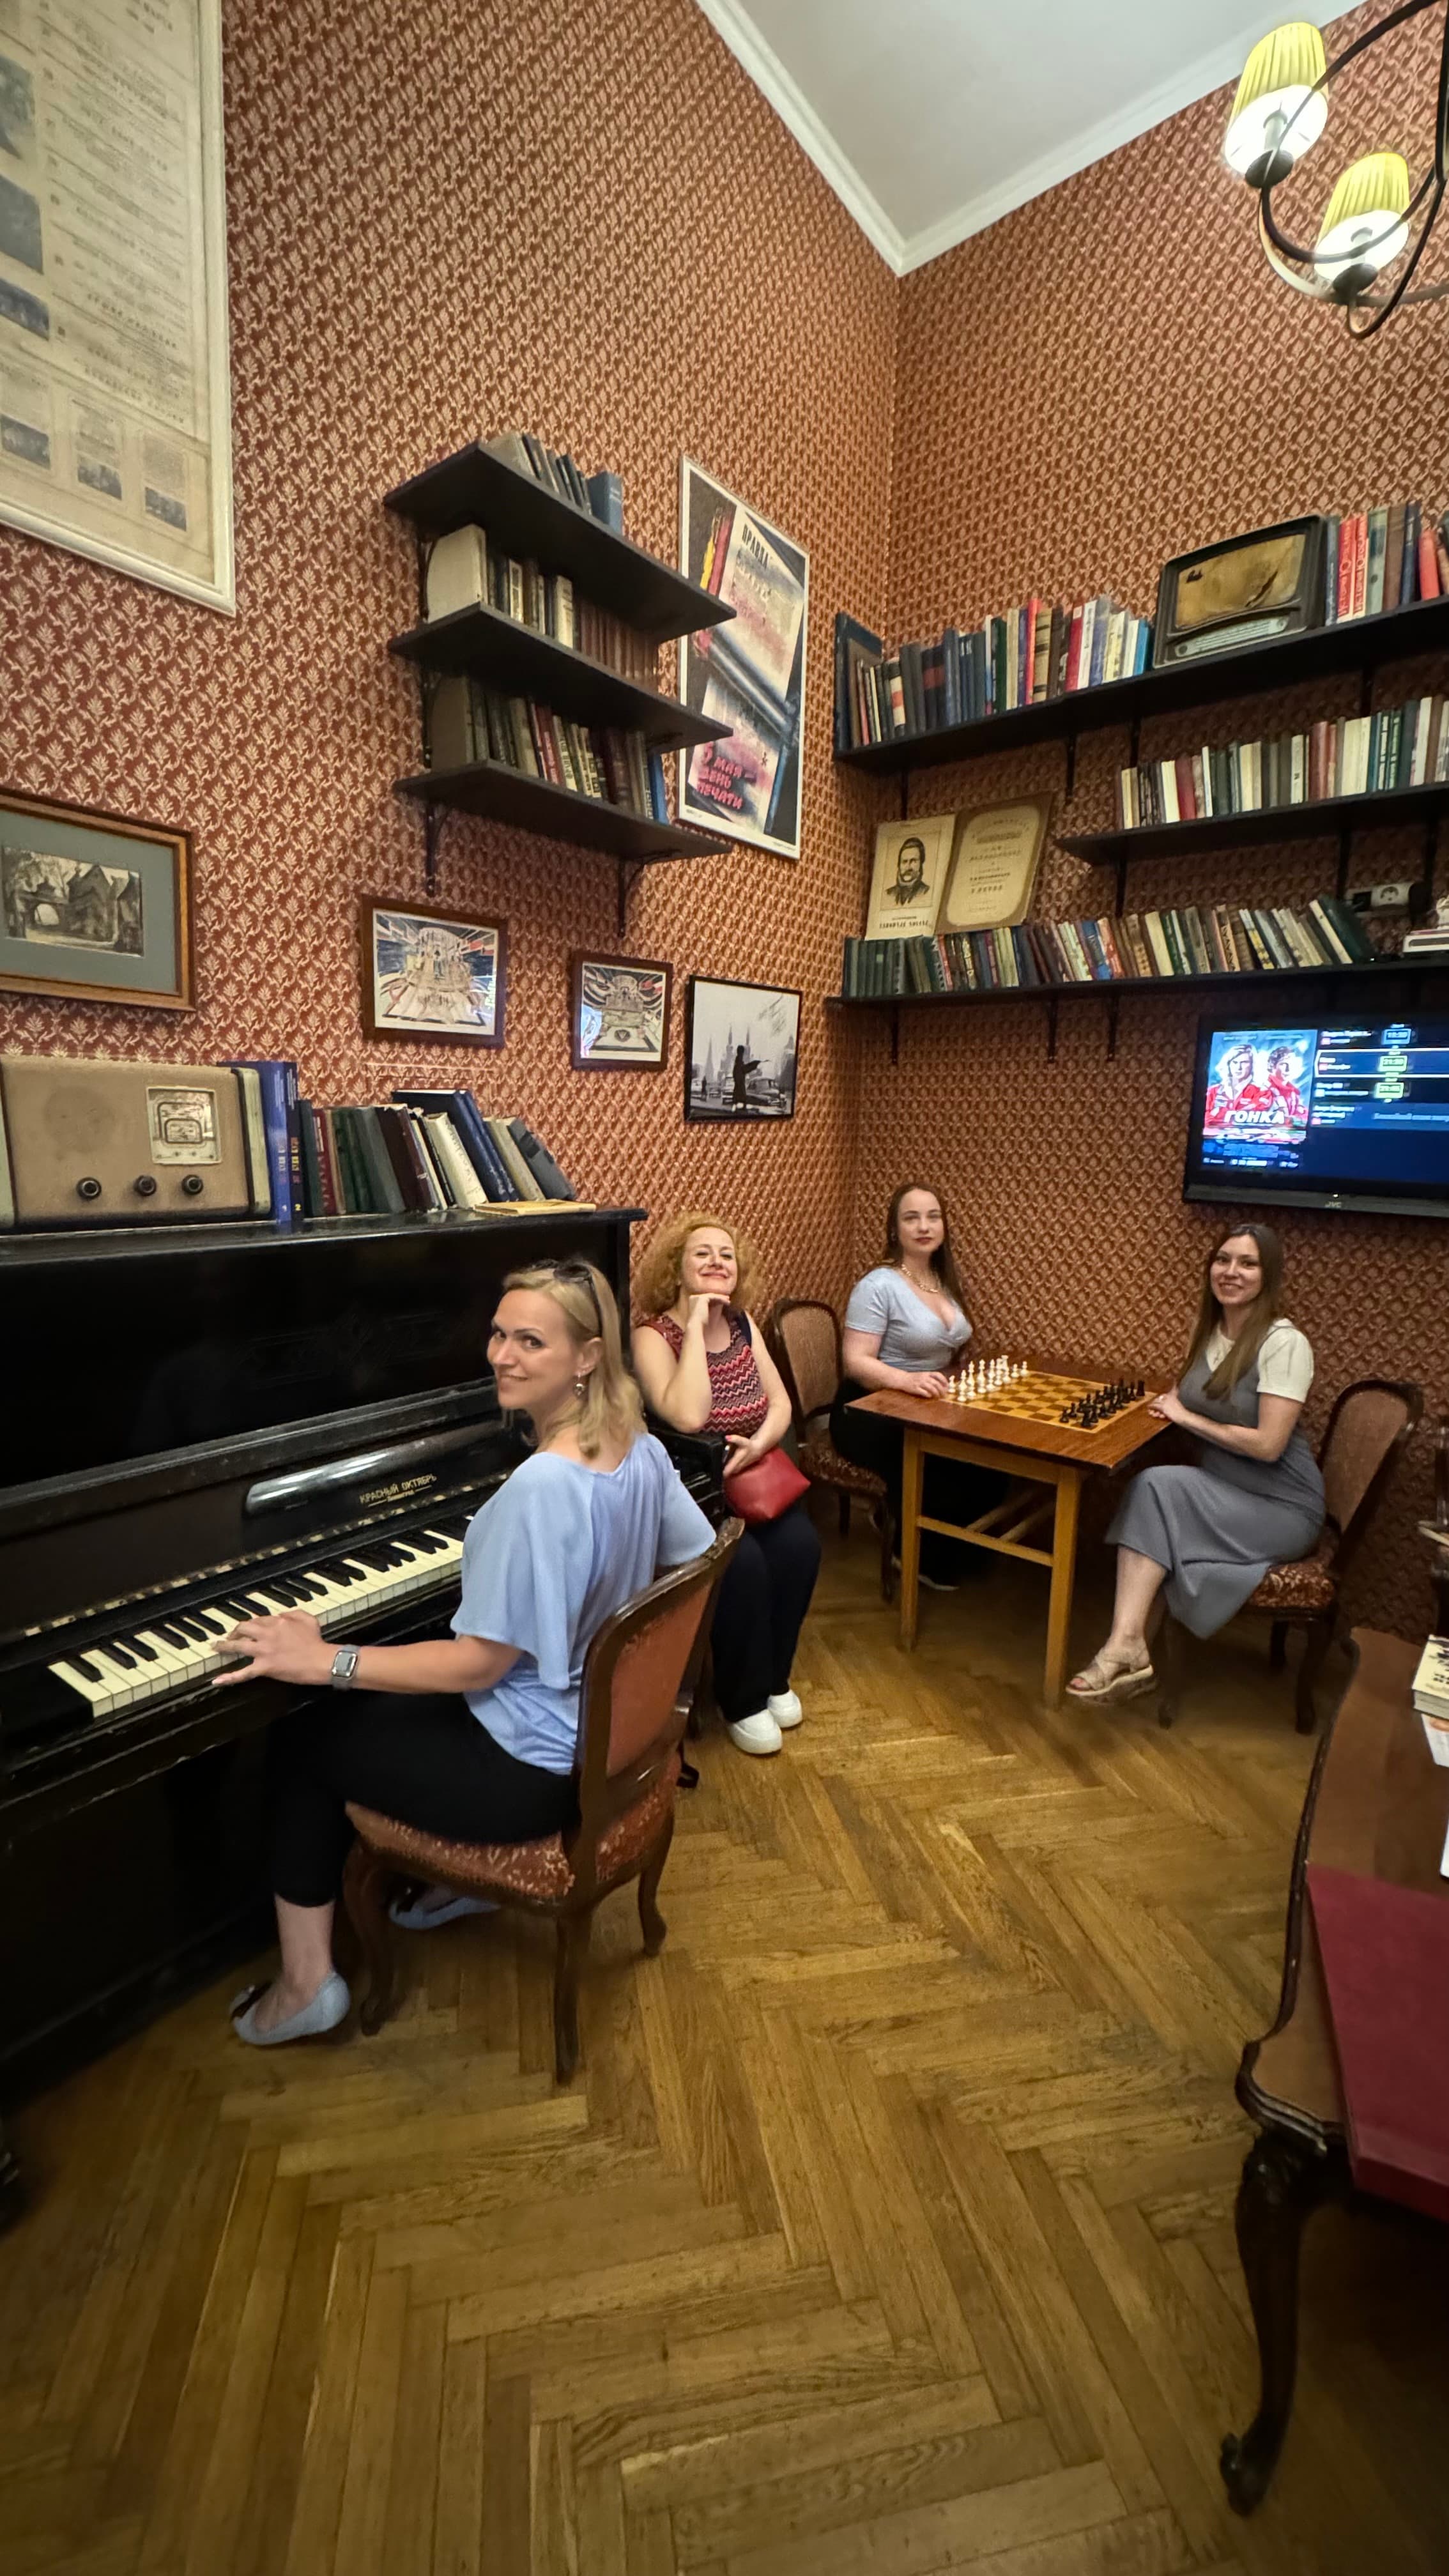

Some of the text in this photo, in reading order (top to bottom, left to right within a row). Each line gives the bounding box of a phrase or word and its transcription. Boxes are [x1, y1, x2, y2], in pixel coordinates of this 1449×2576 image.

[742, 524, 769, 571] ПРАВДА
[702, 742, 714, 764] 5
[1223, 1110, 1285, 1124] ГОНКА
[295, 1203, 302, 1211] 2
[359, 1483, 399, 1505] КРАСНЫЙ
[401, 1473, 438, 1491] ОКТЯБРЬ
